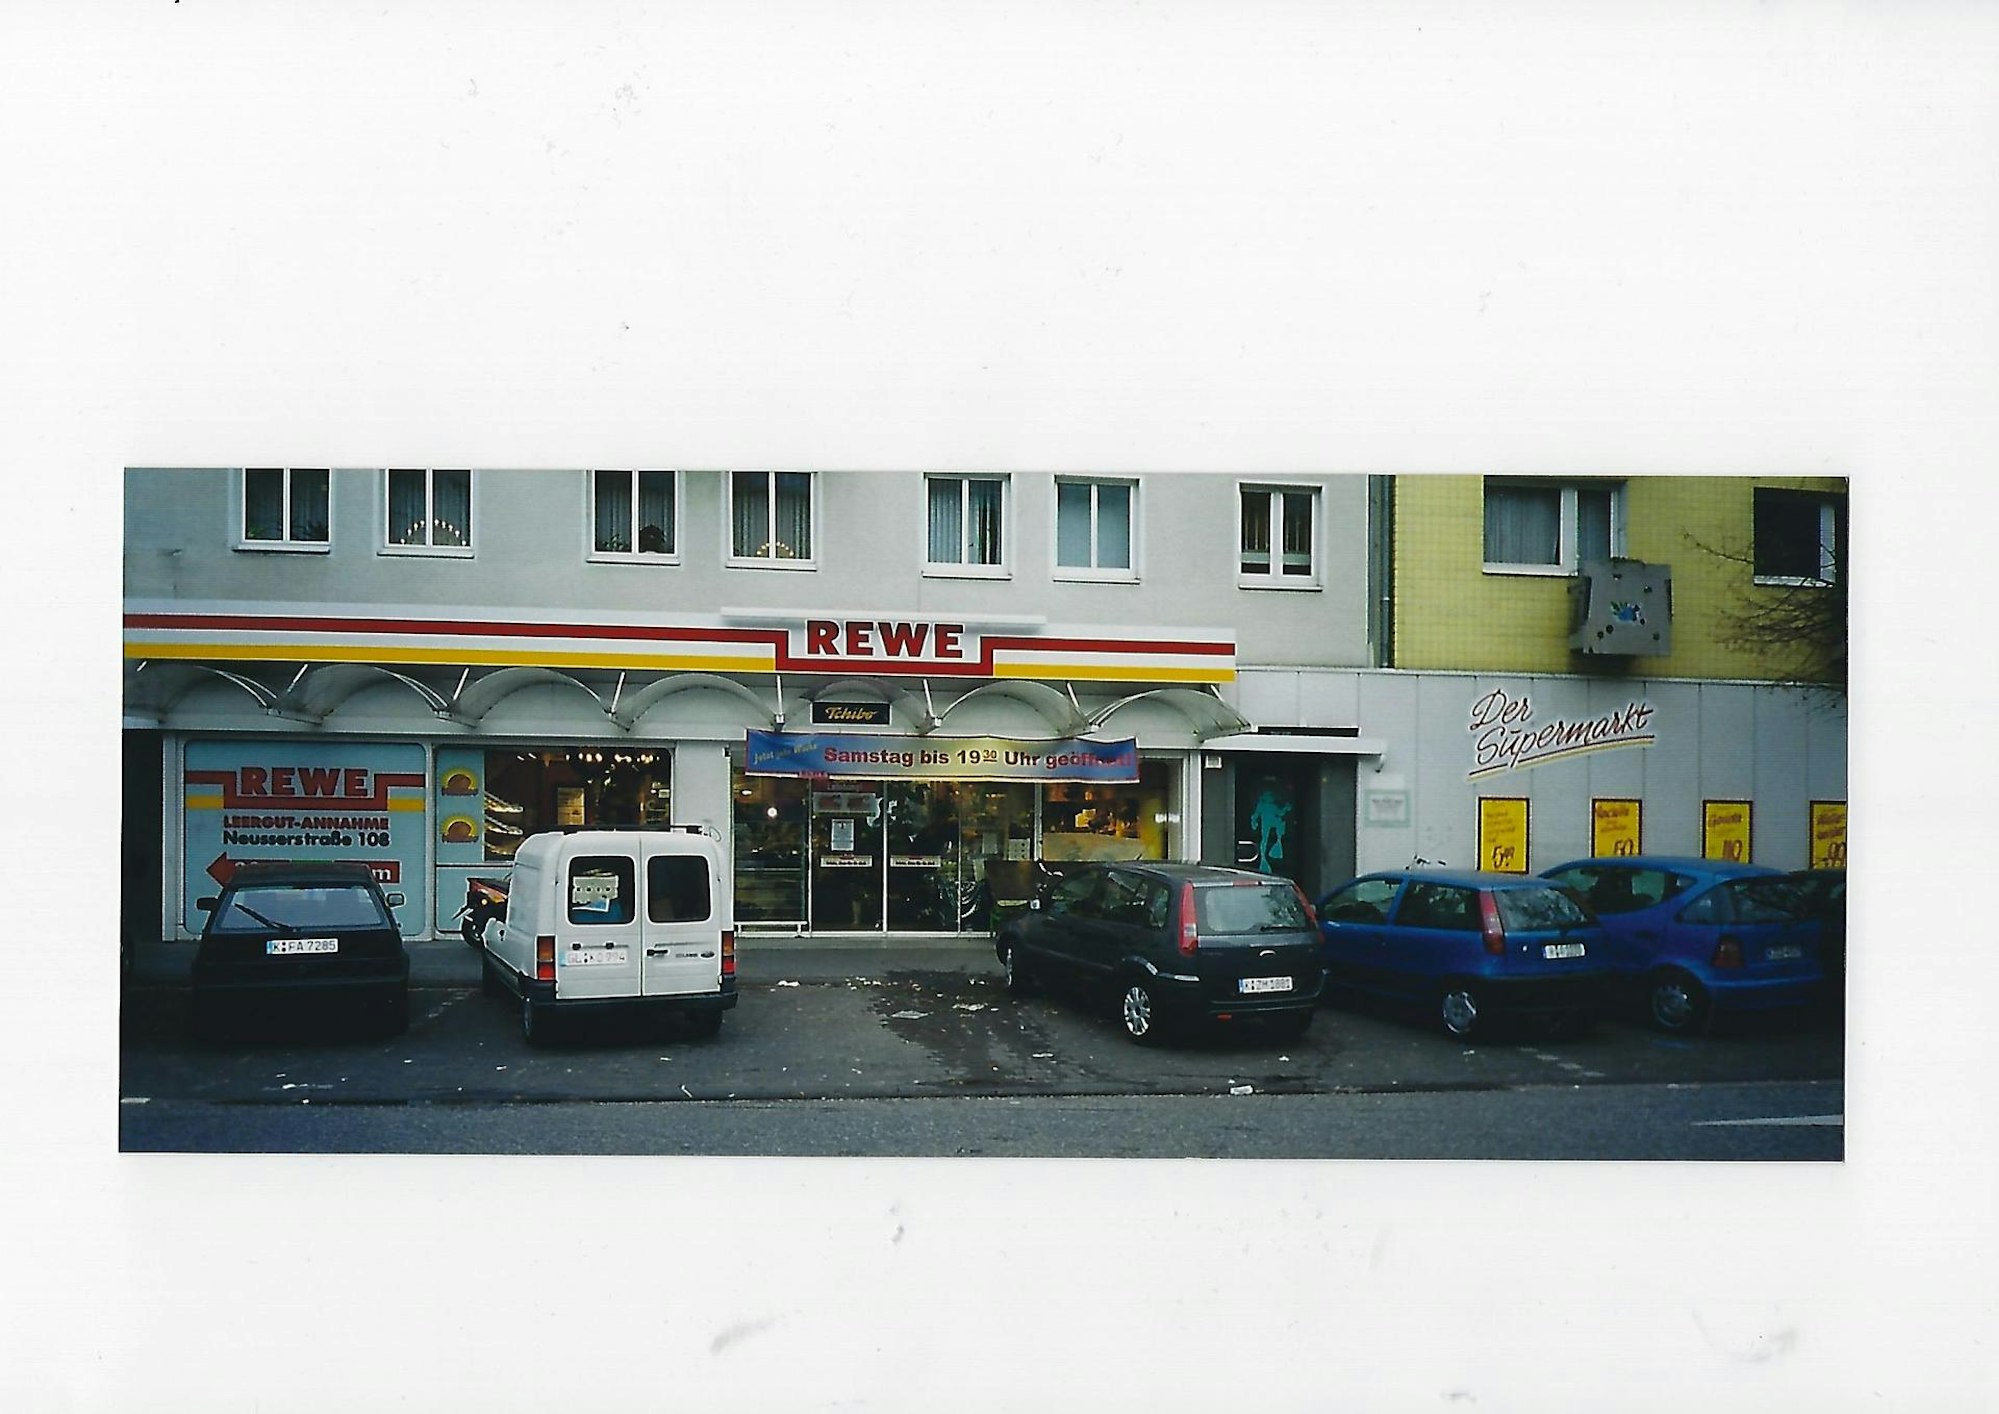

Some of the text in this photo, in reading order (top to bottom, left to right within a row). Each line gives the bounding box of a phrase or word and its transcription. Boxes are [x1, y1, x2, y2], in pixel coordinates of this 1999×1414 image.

[806, 620, 964, 659] REWE
[825, 706, 878, 721] Tchibo
[1470, 688, 1532, 730] Der
[1477, 702, 1654, 768] Supermarkt
[824, 747, 914, 767] Samstag
[920, 750, 949, 765] bis
[1005, 751, 1041, 766] Uhr
[241, 767, 369, 797] REWE
[223, 815, 390, 830] LEERGUT-ANNAHME
[223, 831, 391, 847] Neusserstraße 108
[272, 942, 281, 953] K
[307, 940, 337, 952] 7285
